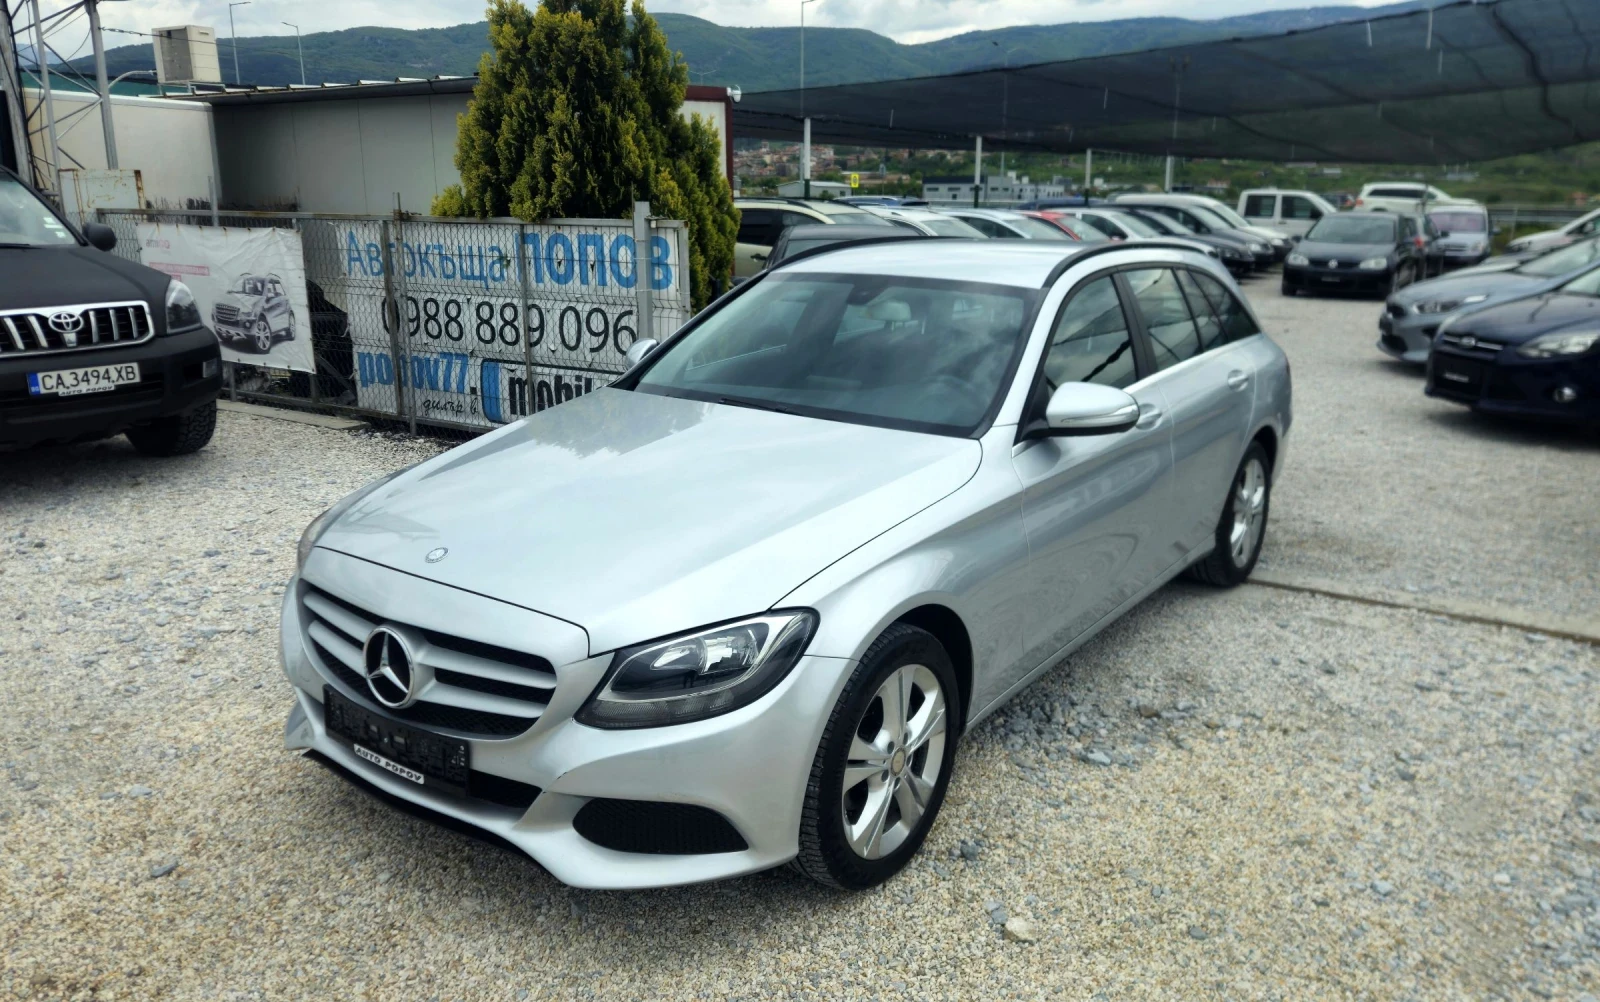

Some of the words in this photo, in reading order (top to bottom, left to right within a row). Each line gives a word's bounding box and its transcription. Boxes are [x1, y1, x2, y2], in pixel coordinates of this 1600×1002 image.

[347, 230, 506, 290] Автокъща
[381, 296, 464, 342] 0988
[476, 301, 545, 348] 889
[559, 306, 637, 356] 096
[85, 385, 113, 393] POPOV
[355, 747, 381, 764] AUTO
[384, 760, 422, 782] POPOV
